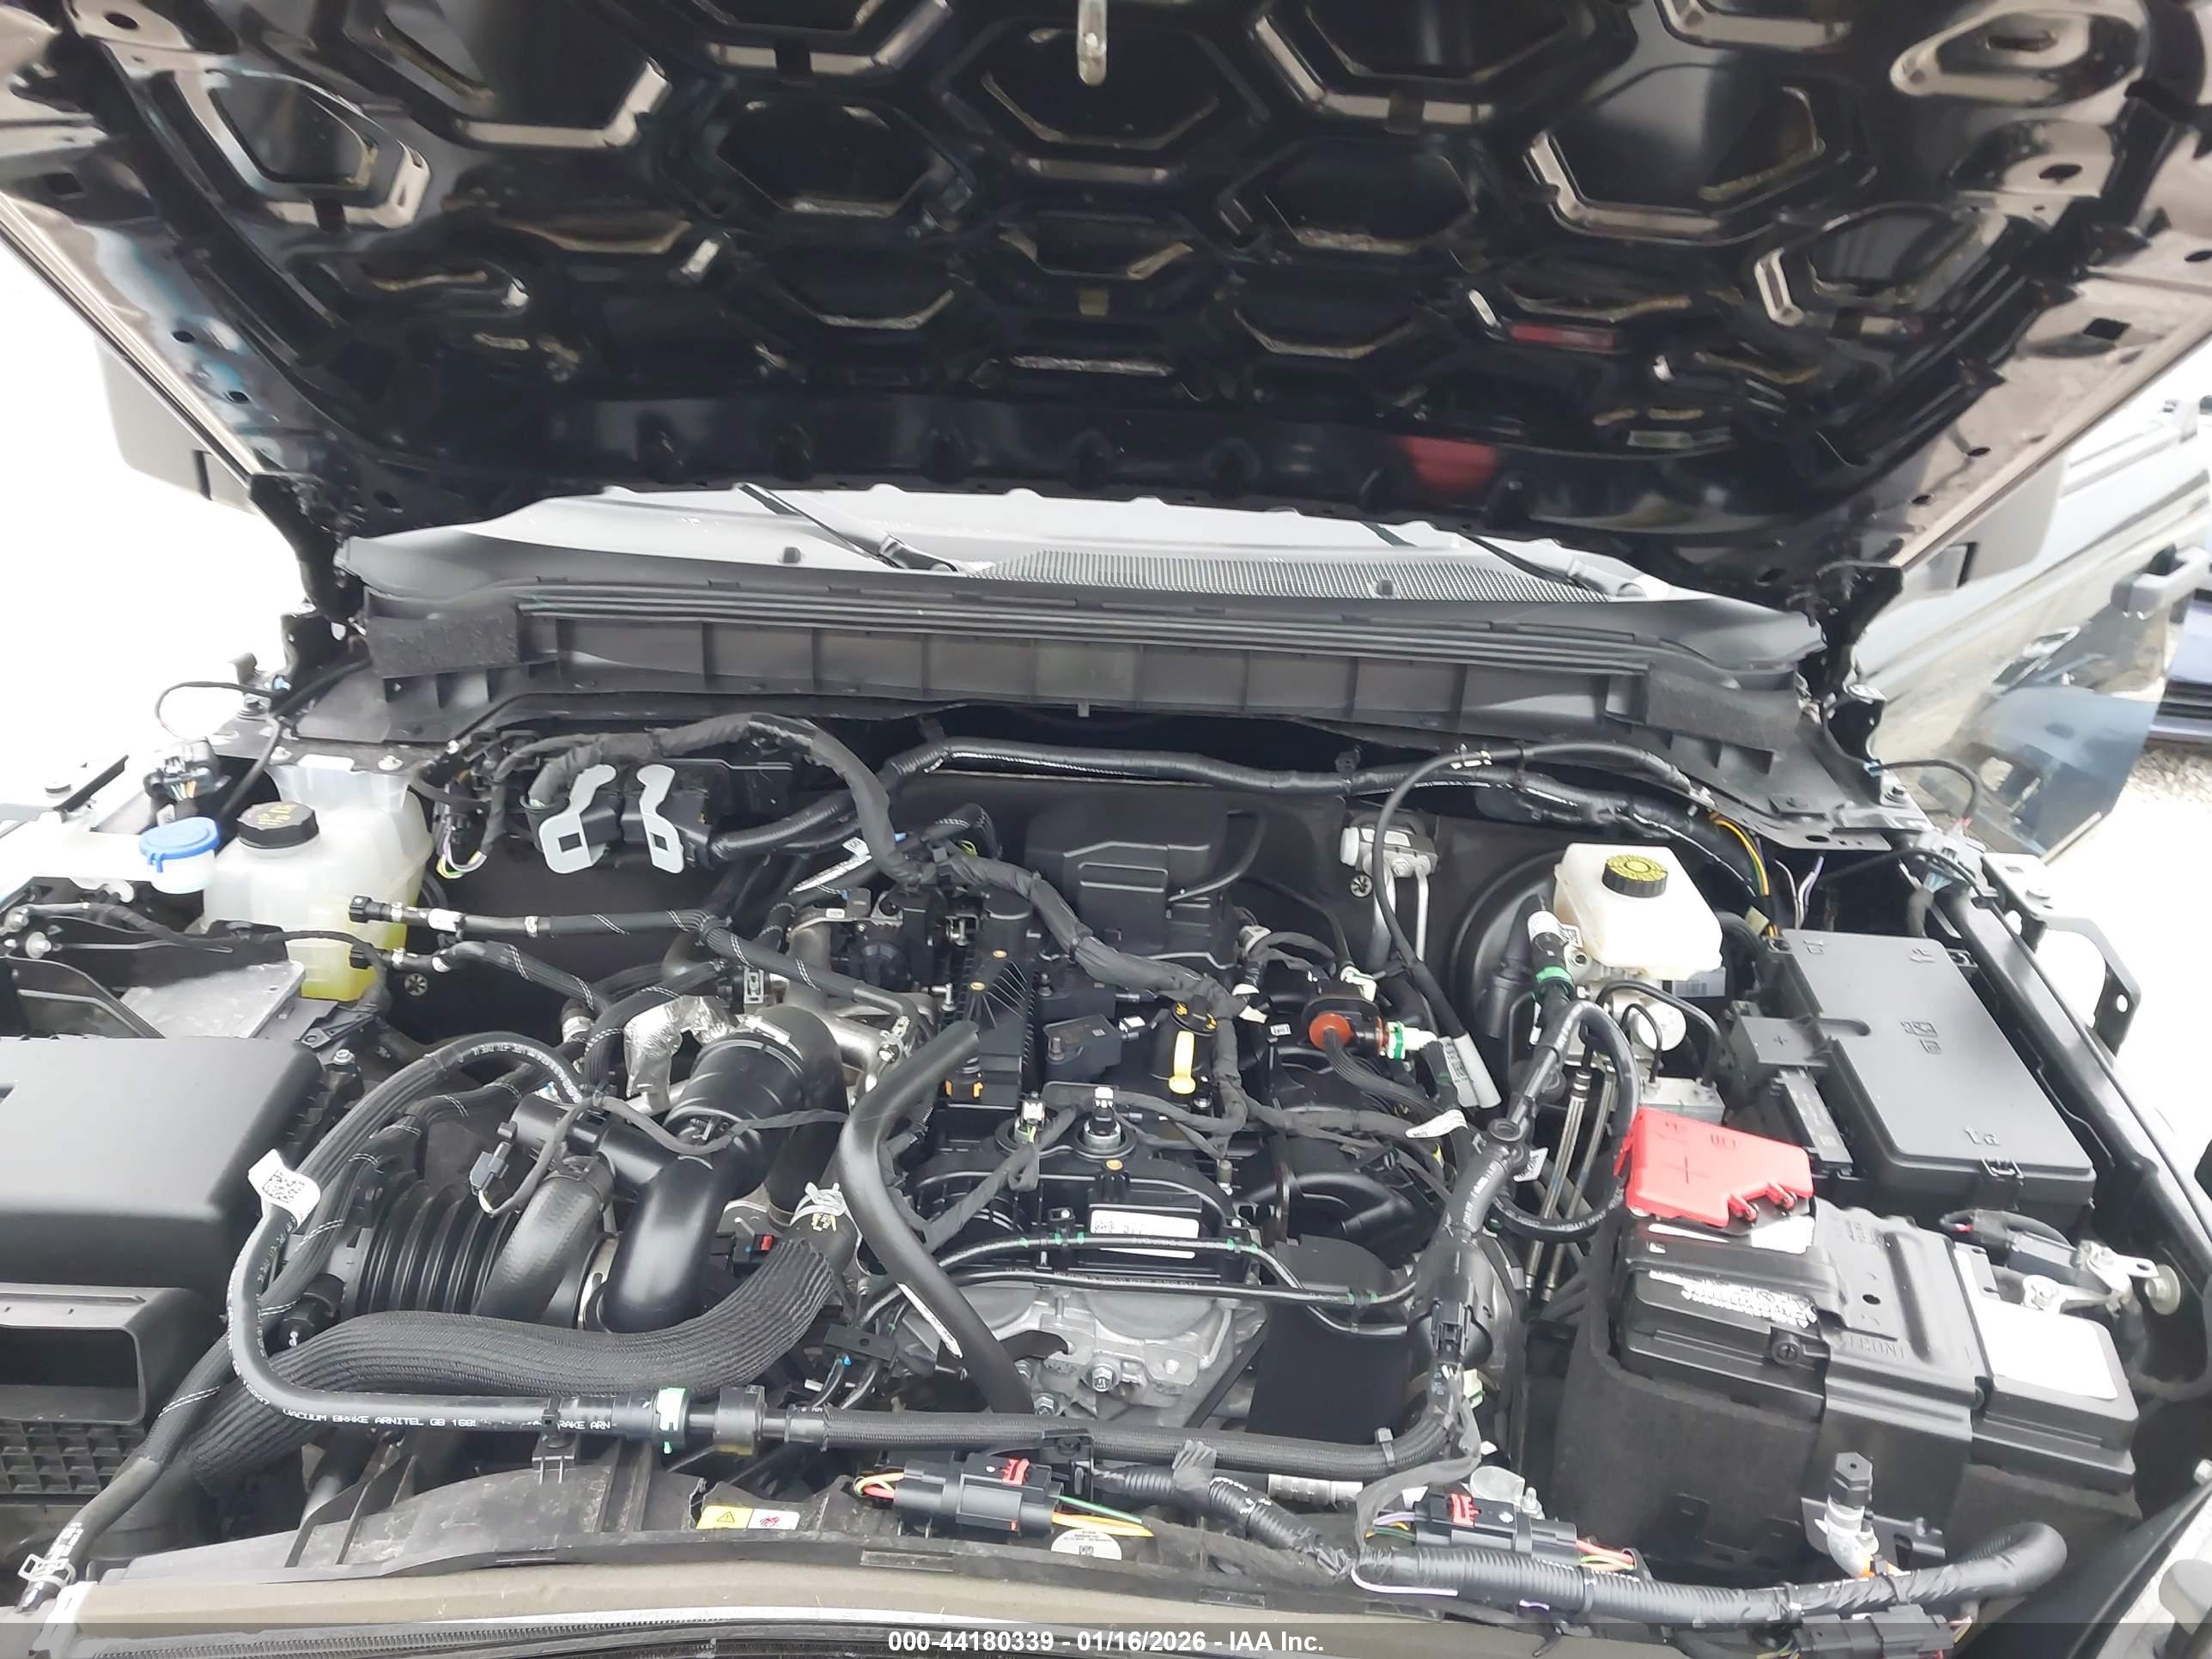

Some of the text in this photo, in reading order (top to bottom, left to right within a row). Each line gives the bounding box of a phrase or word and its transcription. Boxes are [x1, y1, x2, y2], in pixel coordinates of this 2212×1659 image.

[283, 1407, 327, 1423] VACUUM
[332, 1414, 369, 1424] BRAKE
[374, 1416, 424, 1426] ARNITEL
[429, 1418, 446, 1427] GB
[556, 1419, 586, 1430] RAKE
[590, 1420, 617, 1430] ARN
